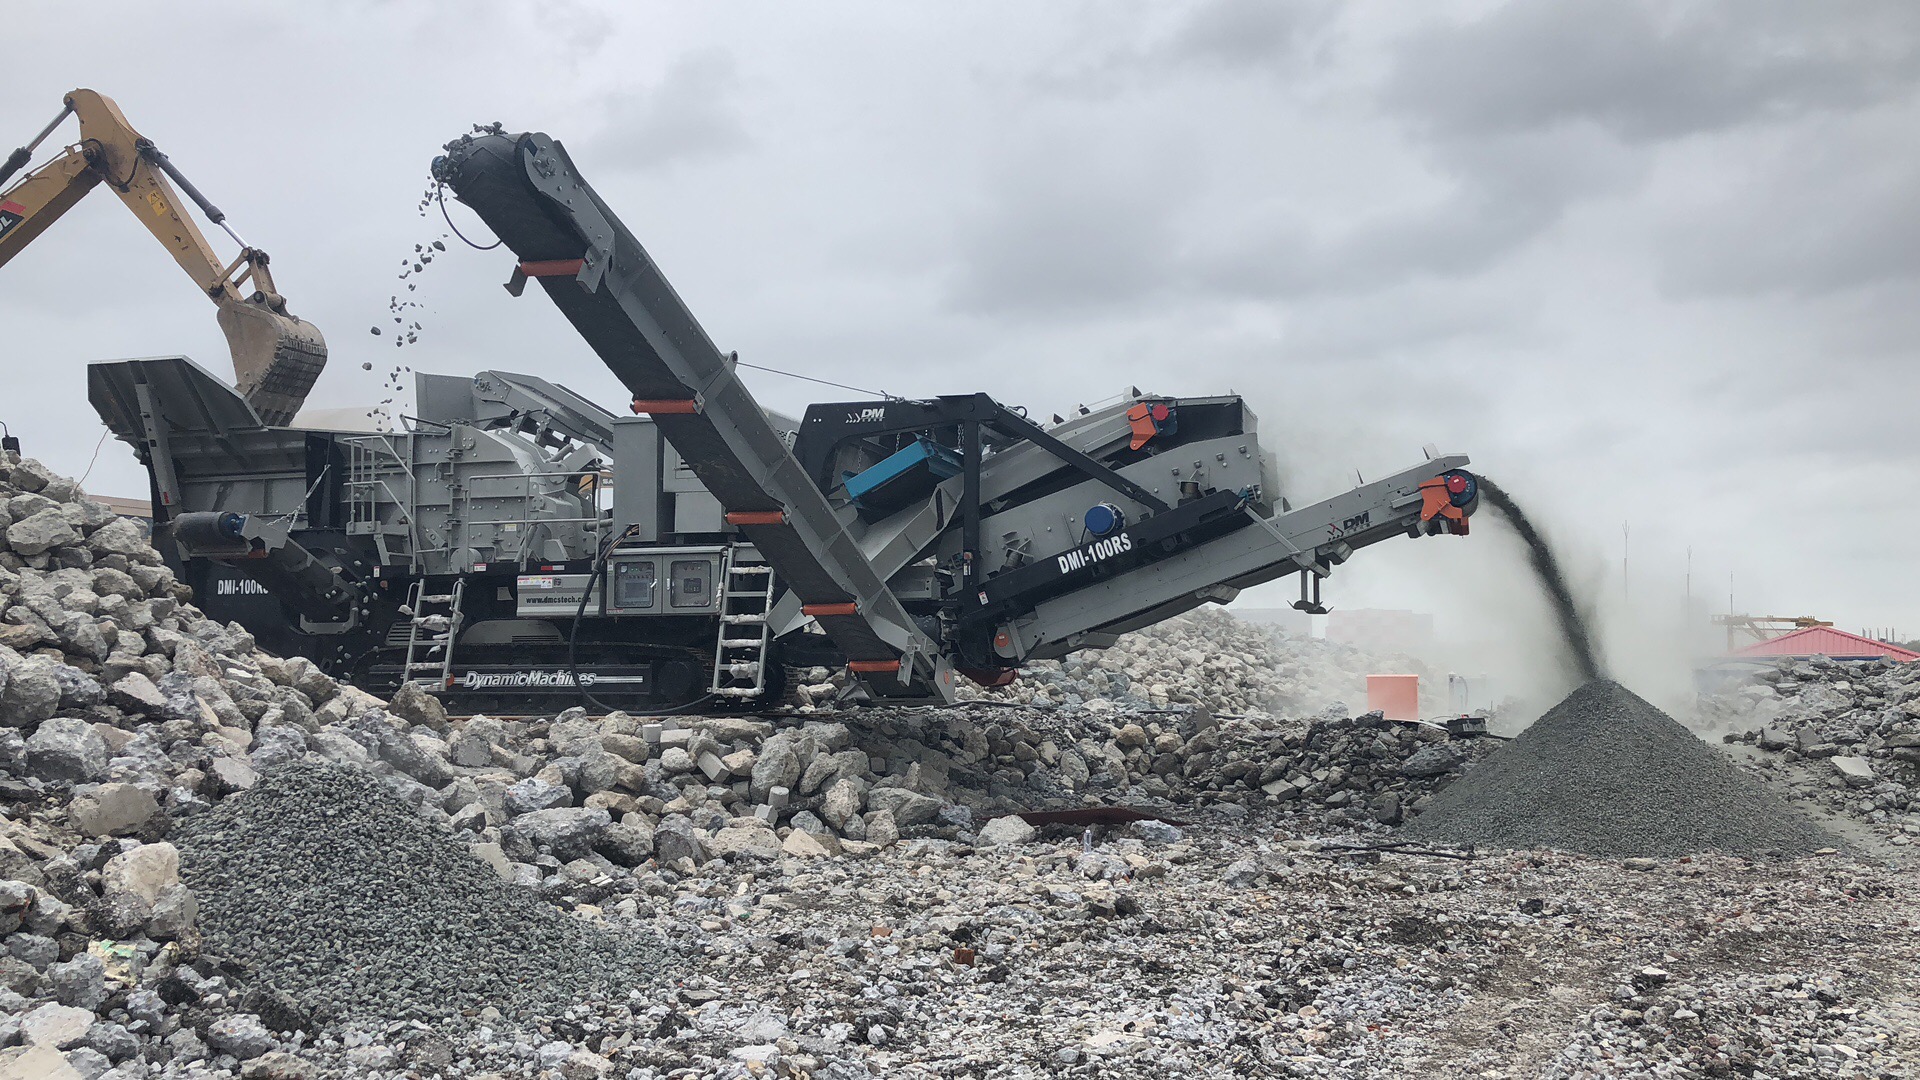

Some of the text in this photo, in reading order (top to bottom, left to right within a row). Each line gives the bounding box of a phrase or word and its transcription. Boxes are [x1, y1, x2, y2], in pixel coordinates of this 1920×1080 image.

[861, 408, 885, 418] DM
[1343, 512, 1370, 530] DM
[1058, 532, 1132, 574] DMI-100RS
